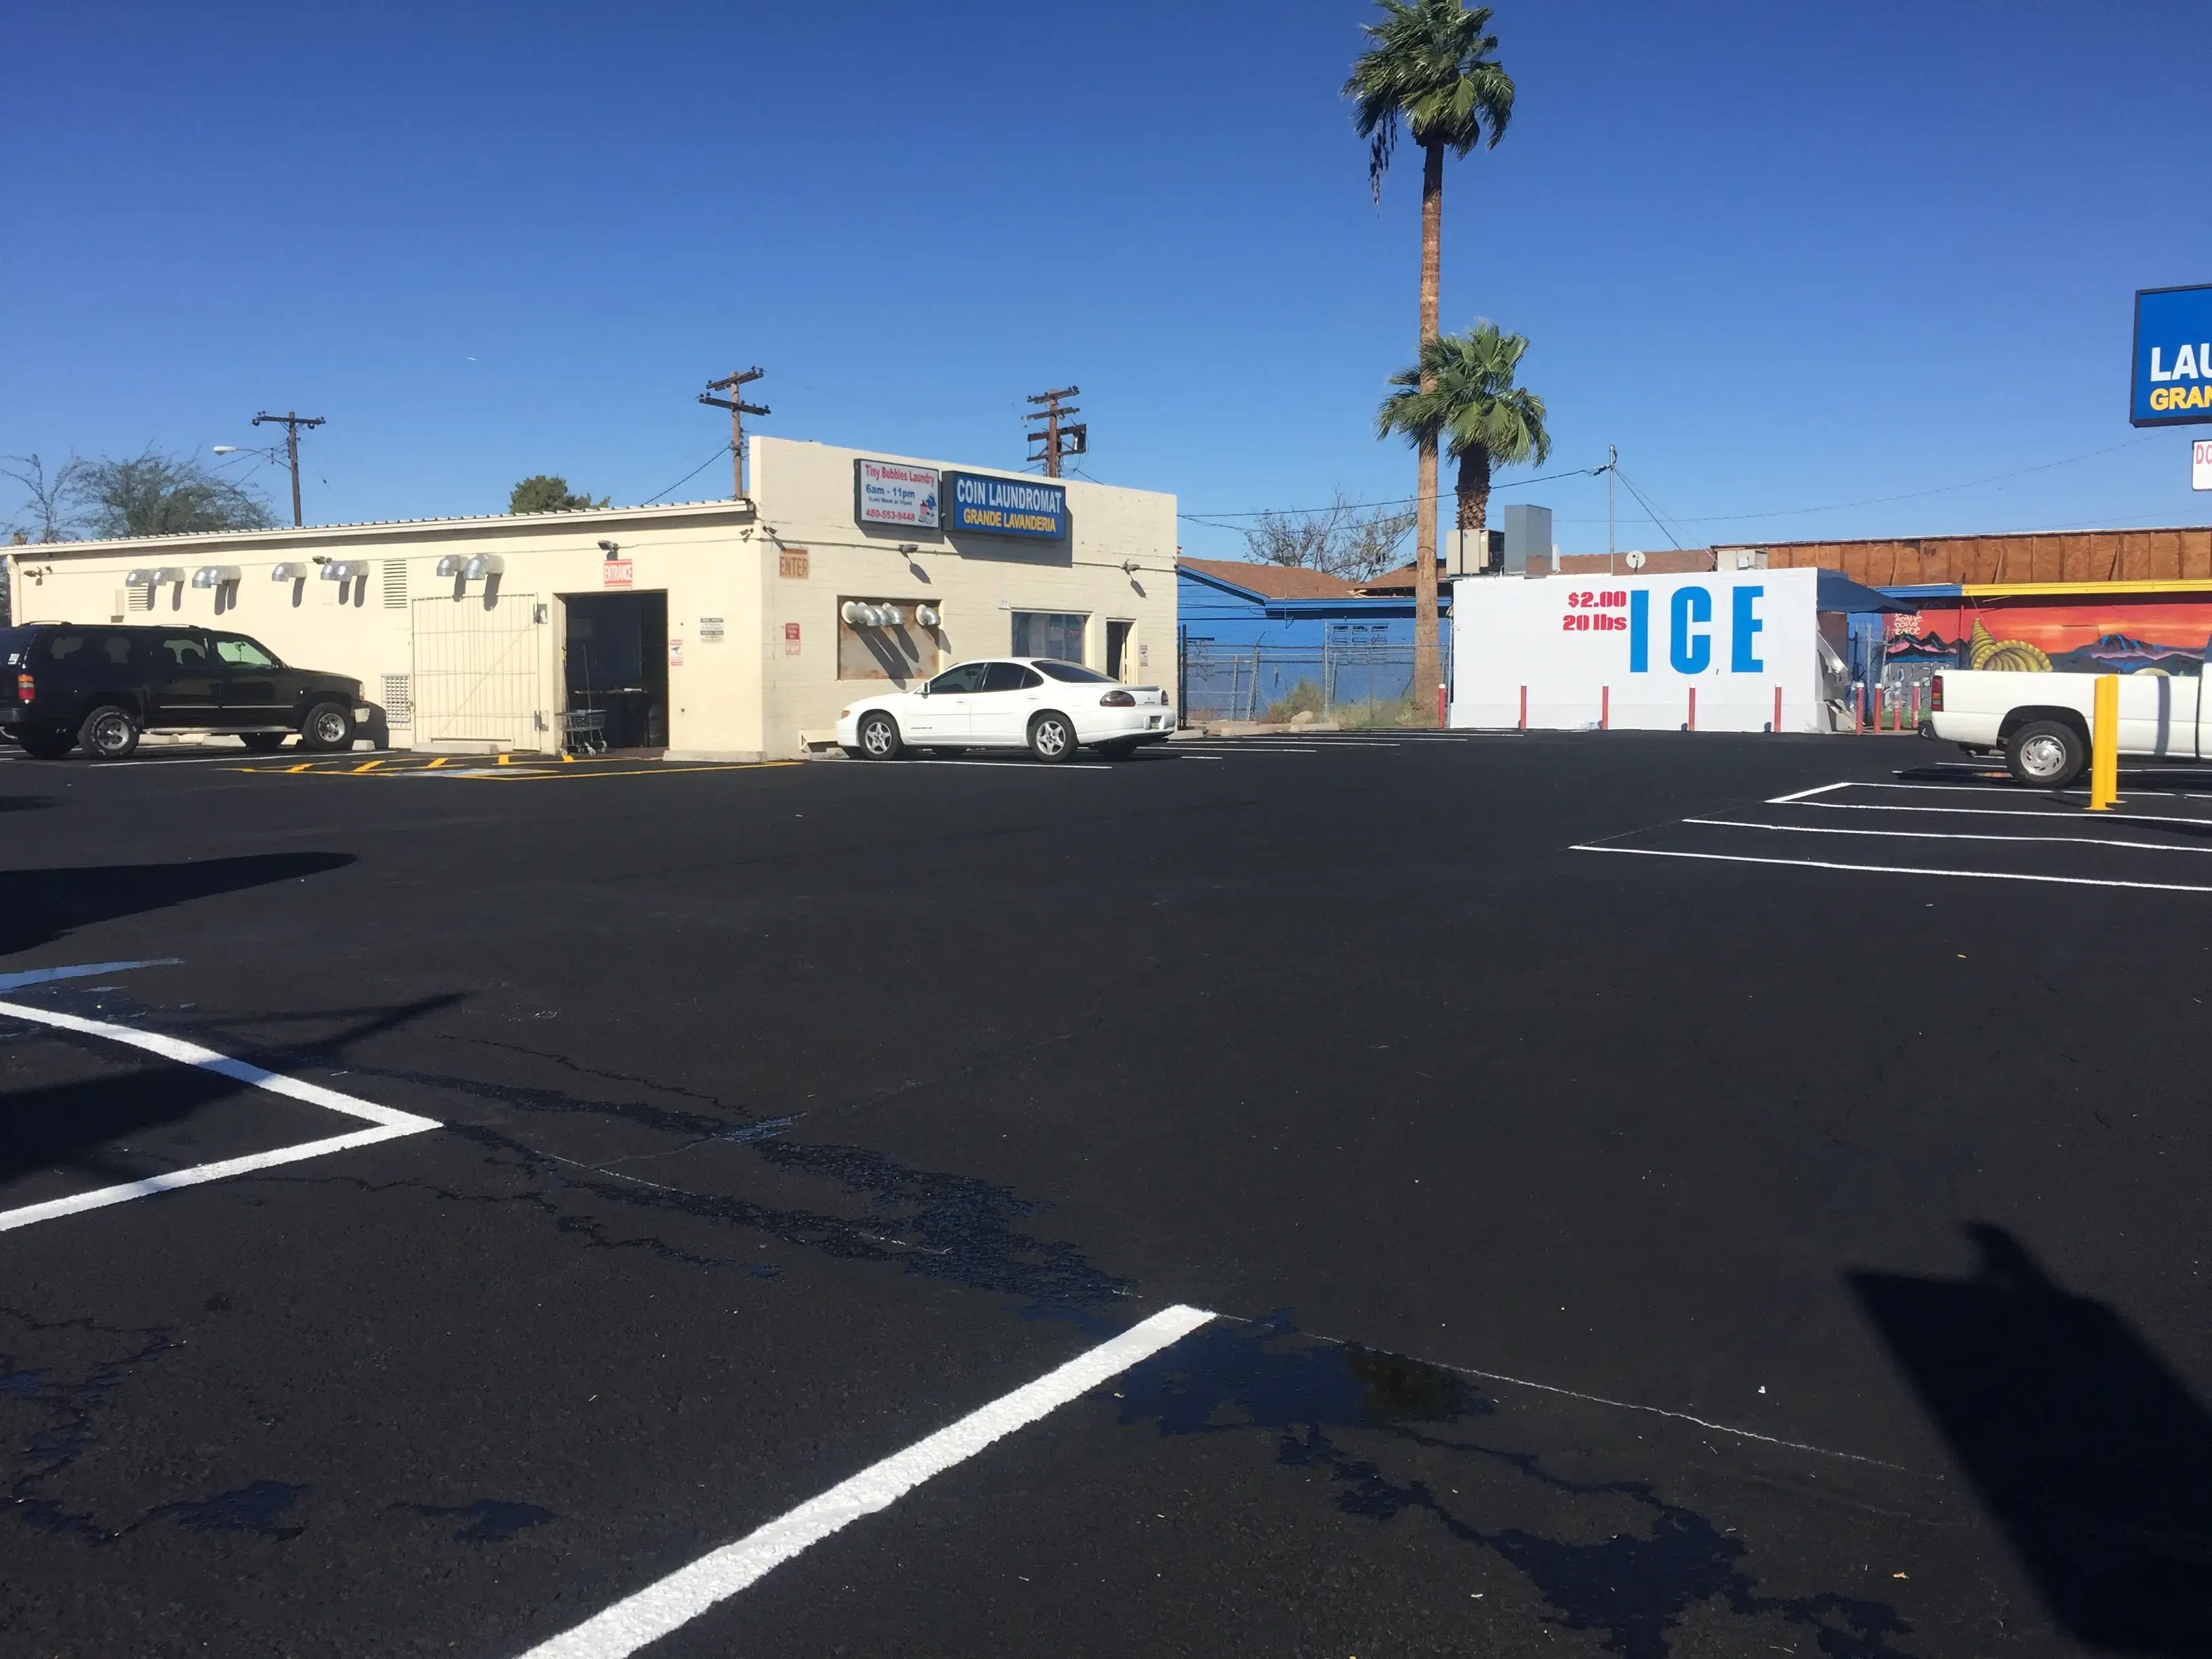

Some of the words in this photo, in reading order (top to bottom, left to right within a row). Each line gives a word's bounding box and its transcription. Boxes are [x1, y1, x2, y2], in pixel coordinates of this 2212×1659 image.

[865, 464, 880, 480] Tiny
[882, 467, 908, 481] Bubbles
[909, 470, 935, 488] Laundry
[865, 484, 884, 495] 6am
[893, 487, 915, 499] 11pm
[957, 479, 985, 505] COIN
[989, 483, 1061, 514] LAUNDROMAT
[964, 508, 1002, 527] GRANDE
[1004, 513, 1056, 533] LAVANDERIA
[604, 564, 632, 581] ENTRANCE
[780, 557, 808, 576] ENTER
[1568, 590, 1626, 608] $2.00
[1563, 615, 1589, 631] 20
[1593, 614, 1627, 631] lbs
[1630, 586, 1764, 674] ICE
